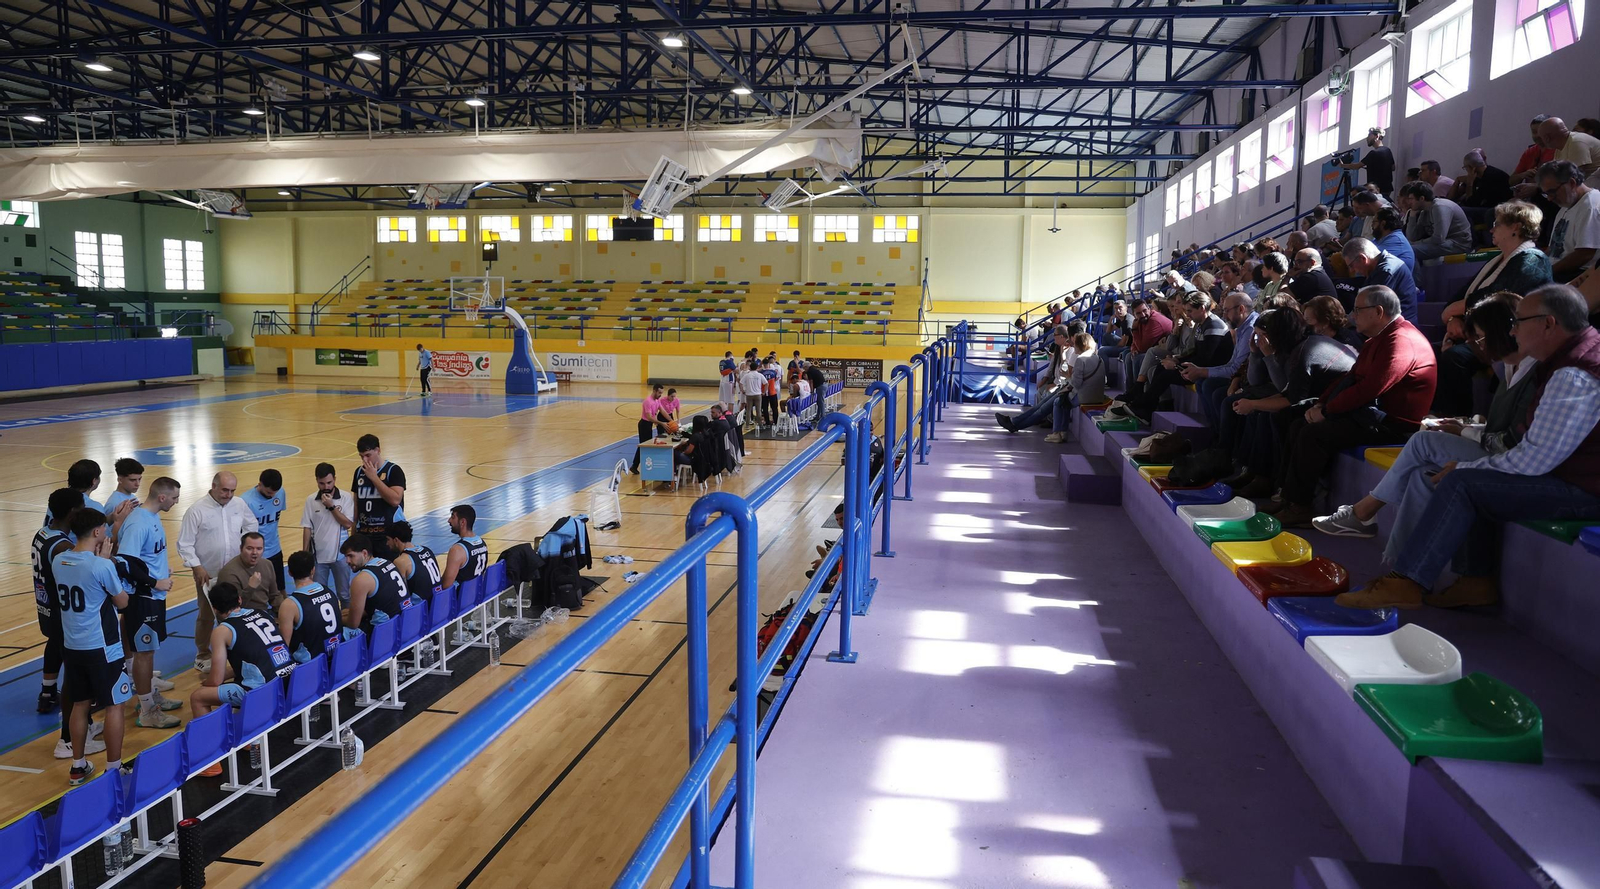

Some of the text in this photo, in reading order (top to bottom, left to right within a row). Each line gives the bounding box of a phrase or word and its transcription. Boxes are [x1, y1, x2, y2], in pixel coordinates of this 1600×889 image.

[551, 354, 612, 367] Sumitecni
[365, 500, 372, 512] 0
[390, 570, 408, 598] 3
[421, 557, 441, 585] 10
[57, 583, 86, 613] 30
[245, 617, 283, 645] 12
[320, 602, 338, 634] 9
